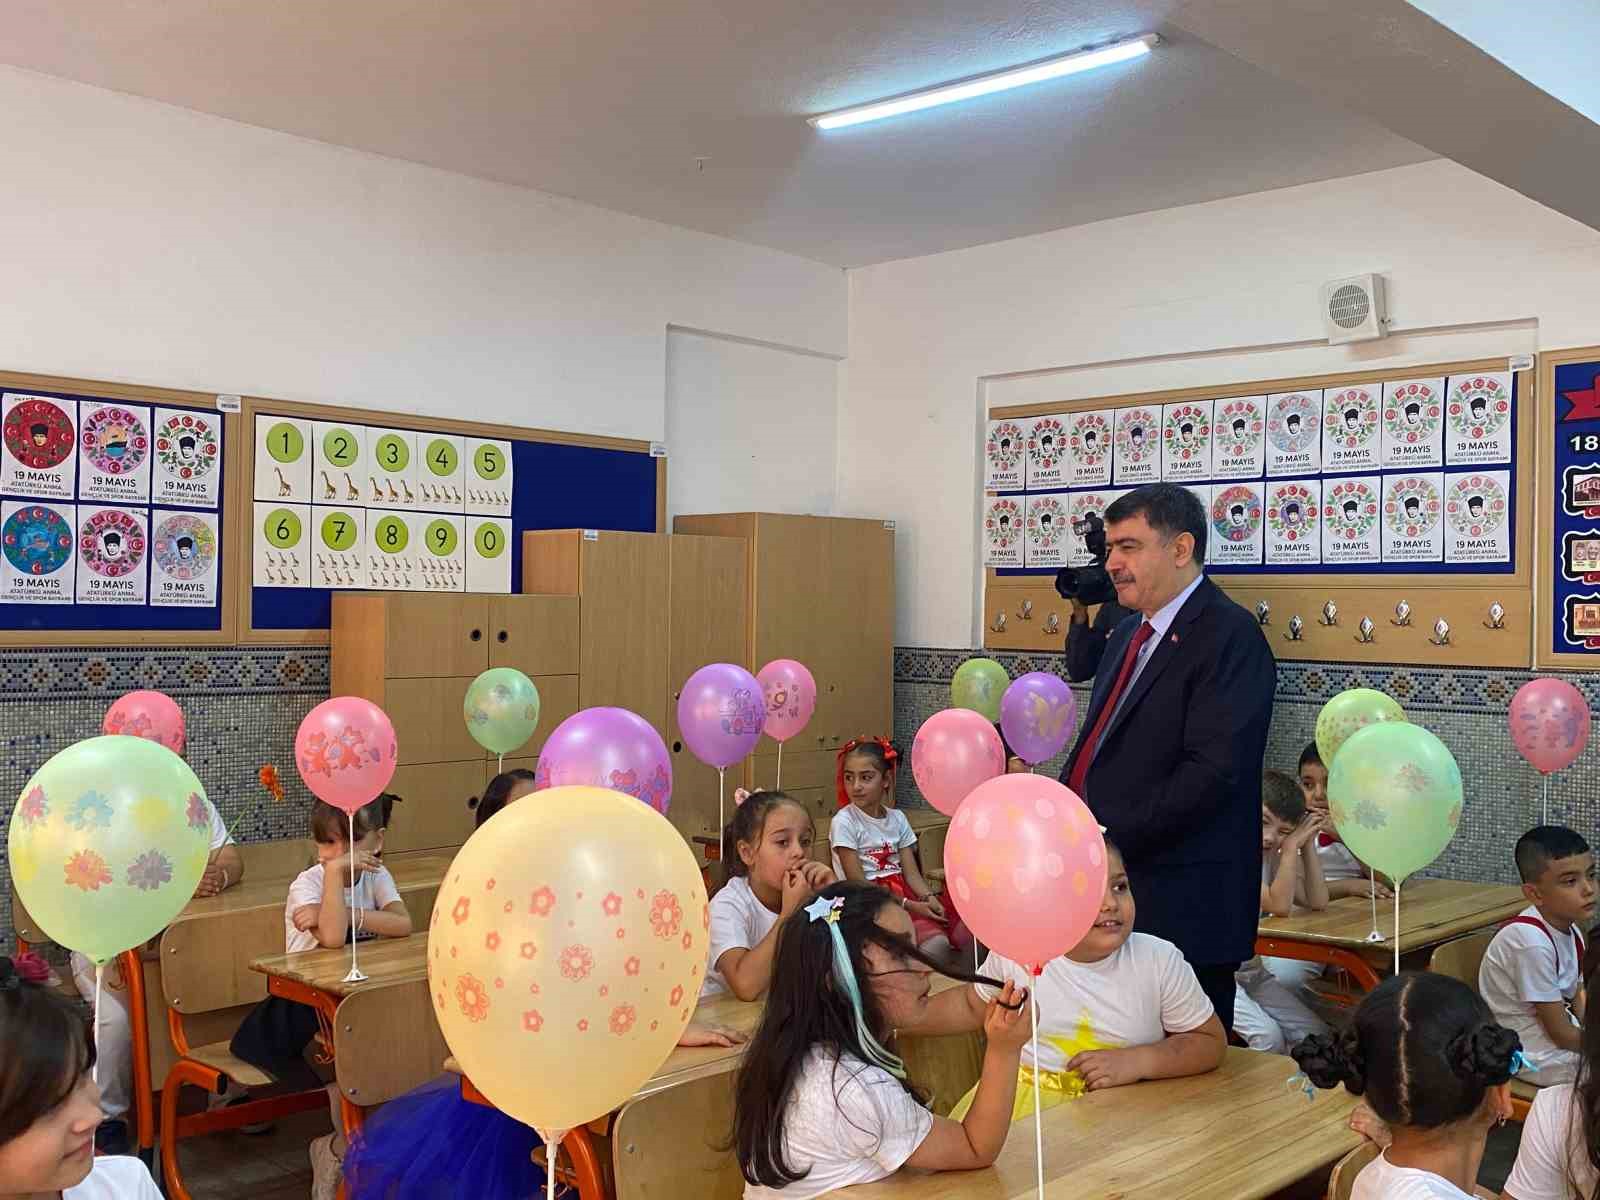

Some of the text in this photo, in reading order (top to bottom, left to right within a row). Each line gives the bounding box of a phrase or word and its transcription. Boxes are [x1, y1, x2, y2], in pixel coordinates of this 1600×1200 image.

[282, 432, 289, 454] 1
[334, 437, 348, 459] 2
[1469, 441, 1498, 450] MAYIS
[386, 443, 398, 464] 3
[1344, 449, 1370, 458] MAYIS
[1403, 445, 1431, 454] MAYIS
[436, 447, 448, 468] 4
[484, 452, 496, 472] 5
[1285, 454, 1310, 462] MAYIS
[1130, 464, 1151, 472] MAYIS
[1180, 461, 1202, 469] MAYIS
[1084, 467, 1104, 475] MAYIS
[15, 471, 61, 482] 19 MAYIS
[92, 476, 136, 487] 19 MAYIS
[165, 481, 206, 492] 19 MAYIS
[276, 518, 290, 540] 6
[333, 521, 346, 543] 7
[386, 524, 398, 545] 8
[436, 528, 447, 548] 9
[484, 530, 496, 550] 0
[1403, 540, 1431, 548] MAYIS
[1467, 540, 1496, 548] MAYIS
[1285, 543, 1310, 551] MAYIS
[1342, 542, 1369, 550] MAYIS
[13, 578, 60, 588] 19 MAYIS
[90, 580, 134, 589] 19 MAYIS
[163, 583, 205, 592] 19 MAYIS
